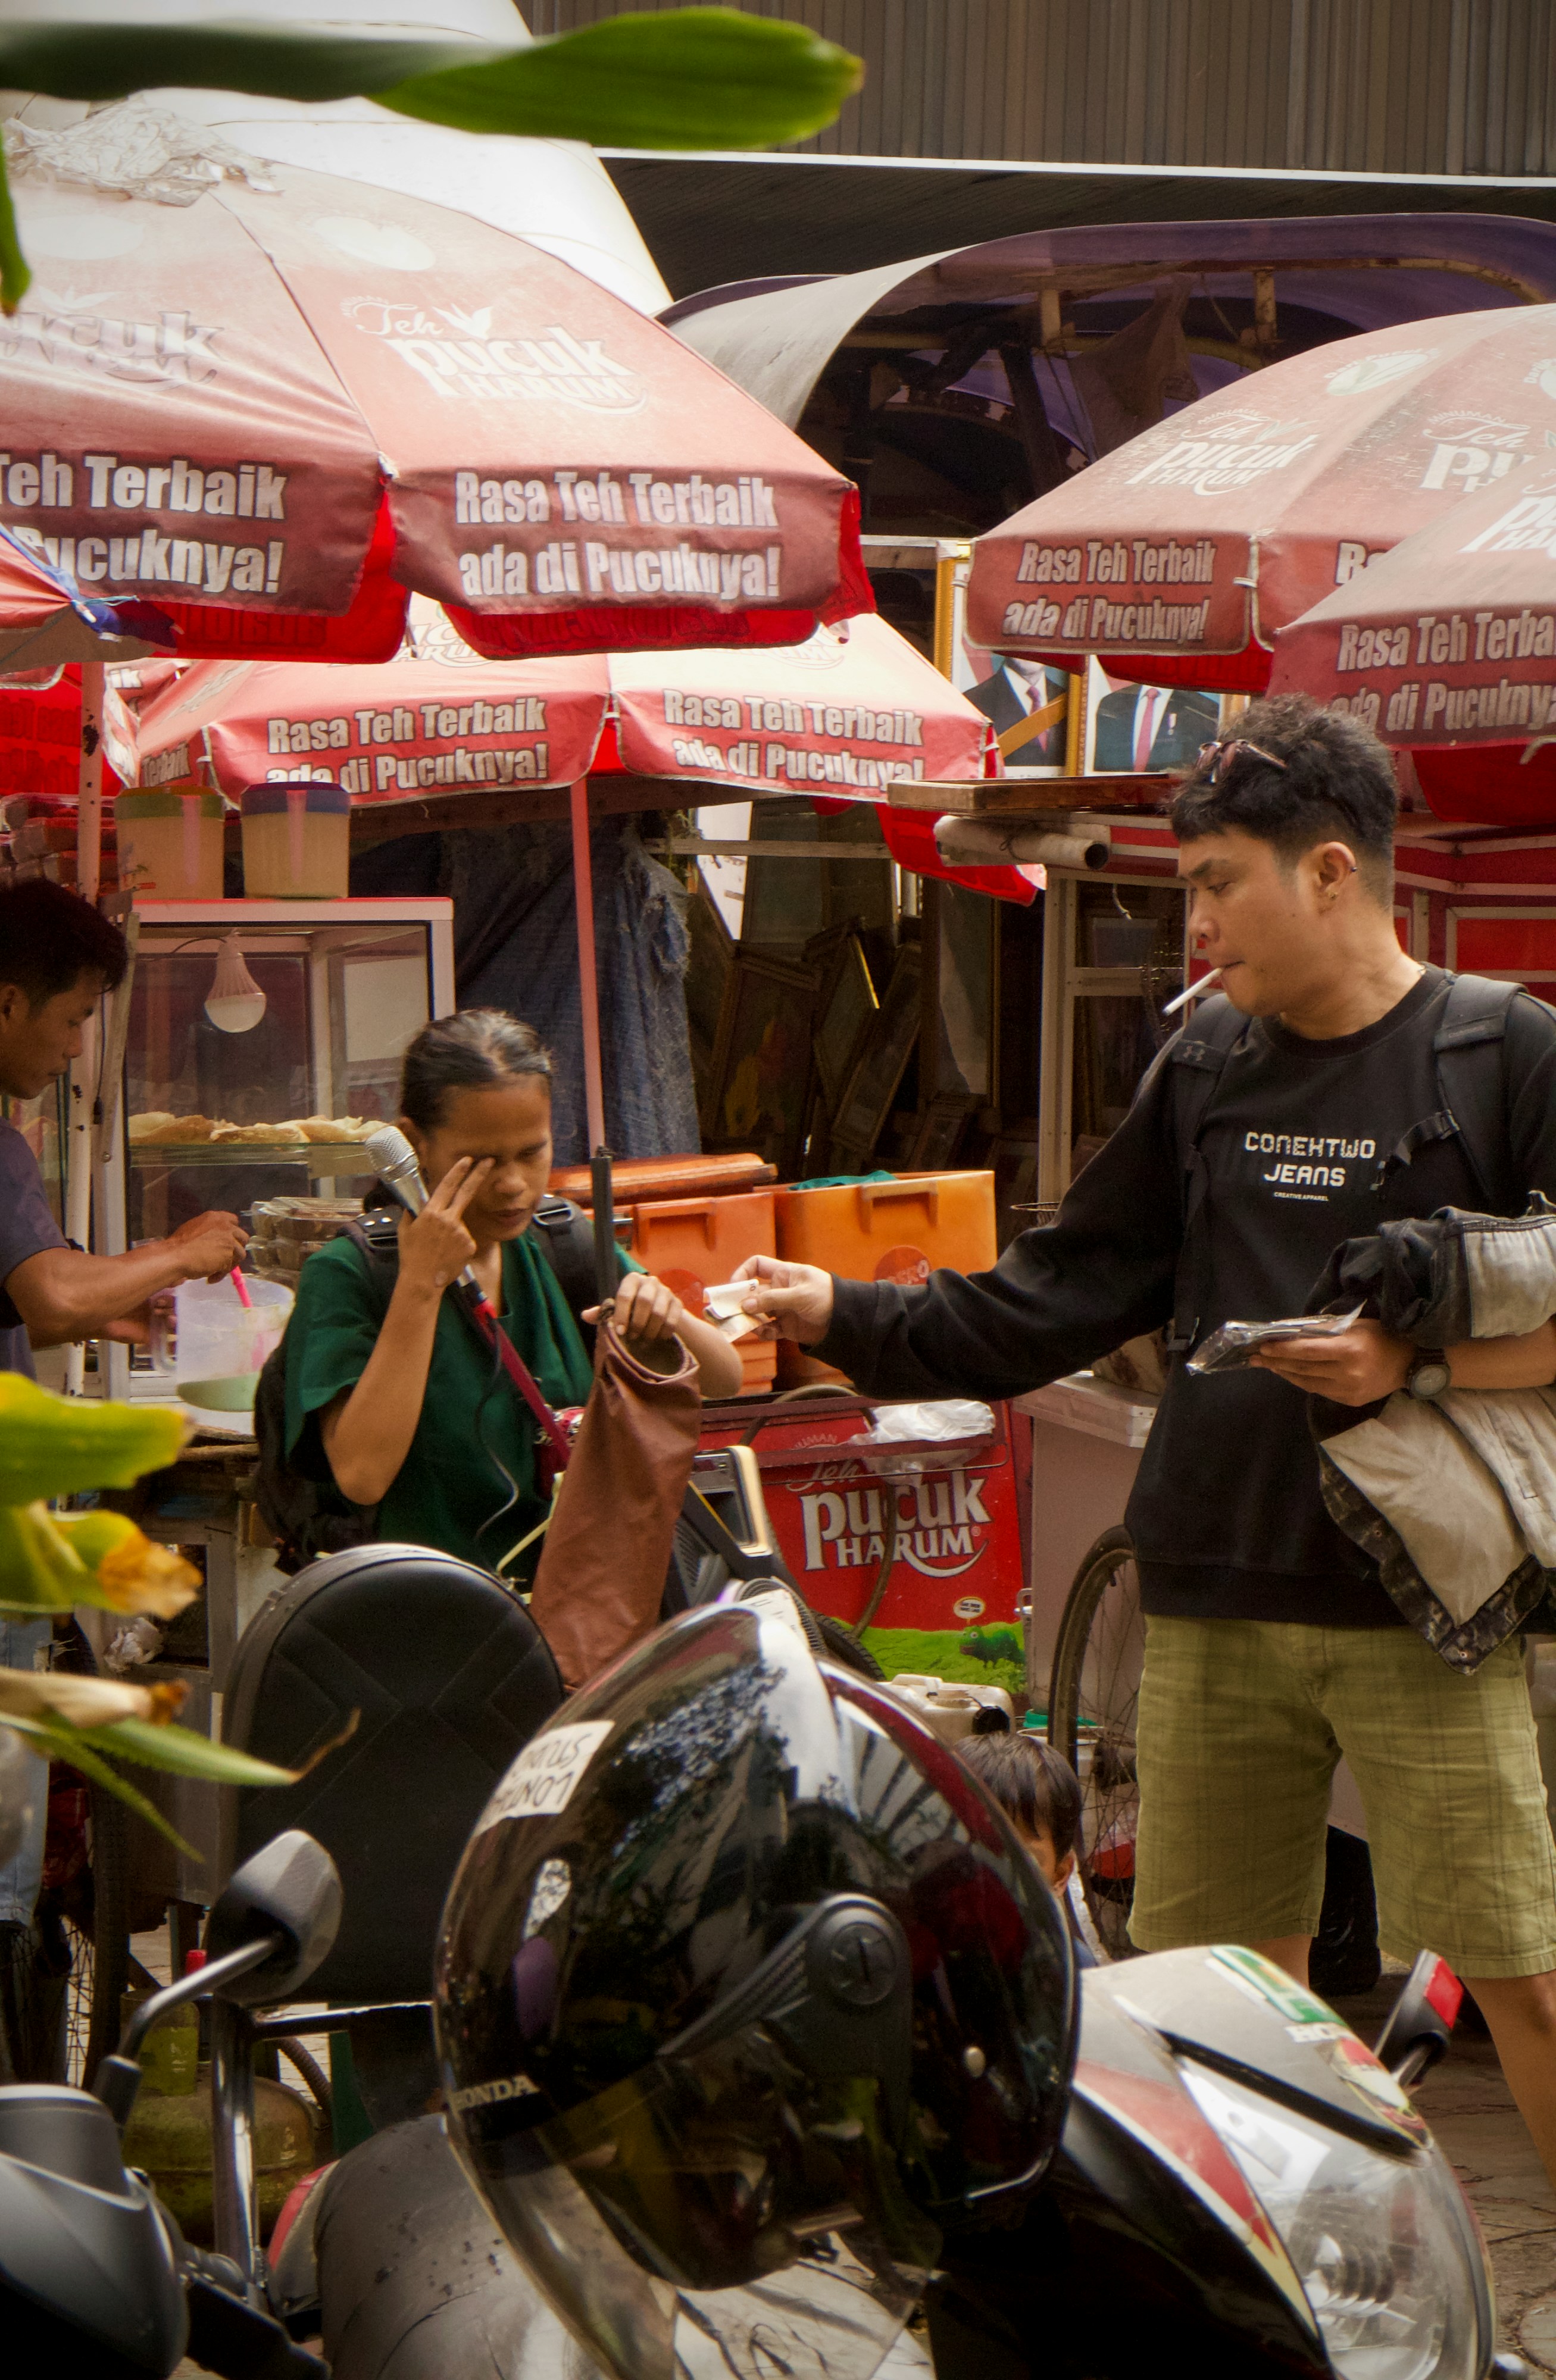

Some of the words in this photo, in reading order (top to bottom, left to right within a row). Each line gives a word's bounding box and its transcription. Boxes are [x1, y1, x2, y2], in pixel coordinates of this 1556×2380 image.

[356, 302, 444, 335] Teh
[382, 324, 638, 398] pucuk
[457, 374, 636, 402] HARUM
[1180, 414, 1271, 439] Teh
[1422, 417, 1532, 446] Teh
[1124, 434, 1319, 484] pucuk
[1148, 468, 1272, 487] HARUM
[0, 454, 73, 507] eh
[84, 455, 287, 520] Terbaik
[455, 472, 549, 523] Rasa
[555, 472, 626, 522] Teh
[630, 474, 779, 526] Terbaik
[460, 544, 528, 596] ada
[537, 542, 581, 593] di
[585, 542, 780, 600] Pucuknya!
[1017, 542, 1081, 582] Rasa
[1087, 541, 1127, 582] Teh
[1133, 540, 1216, 582] Terbaik
[1002, 598, 1061, 637] ada
[1062, 598, 1089, 638] di
[1090, 598, 1210, 644] Pucuknya!
[1338, 624, 1410, 671] Rasa
[1417, 615, 1468, 664] Teh
[1475, 609, 1556, 660] Terba
[268, 718, 349, 753] Rasa
[355, 706, 414, 745] Teh
[420, 696, 546, 739] Terbaik
[664, 689, 741, 729] Rasa
[744, 696, 805, 733] Teh
[806, 700, 923, 746] Terbaik
[1386, 684, 1420, 731] di
[340, 756, 371, 793] di
[376, 743, 548, 792] Pucuknya!
[673, 738, 727, 771] ada
[727, 742, 760, 777] di
[1263, 1163, 1345, 1187] JEANS
[800, 1465, 992, 1571] pucuk
[836, 1526, 975, 1574] HARUM
